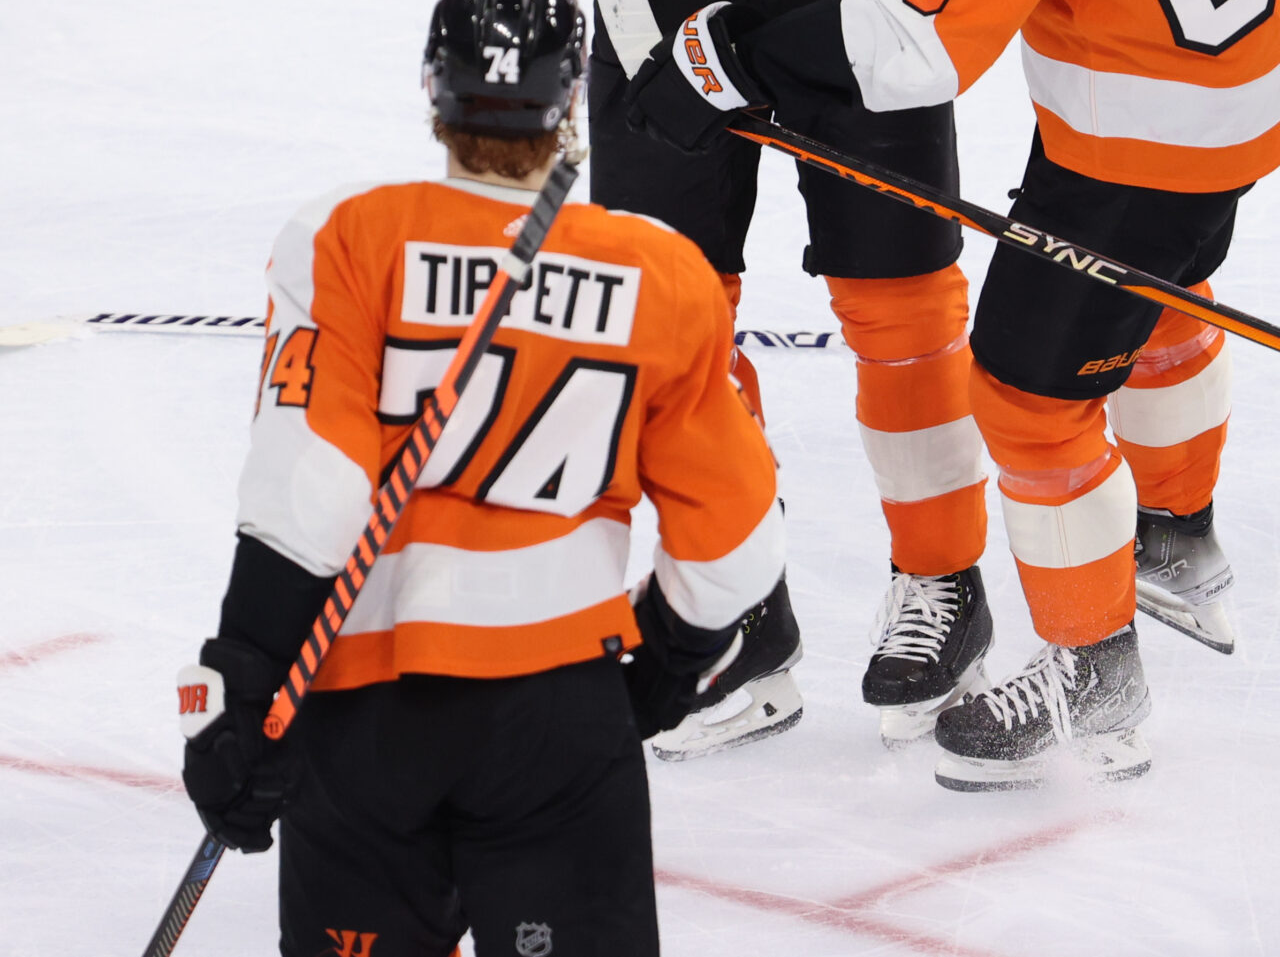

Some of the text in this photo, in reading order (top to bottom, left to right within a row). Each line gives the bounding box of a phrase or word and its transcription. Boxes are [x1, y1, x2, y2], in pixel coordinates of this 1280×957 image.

[483, 46, 520, 84] 74
[1003, 222, 1128, 285] SYNC
[376, 334, 637, 519] 74
